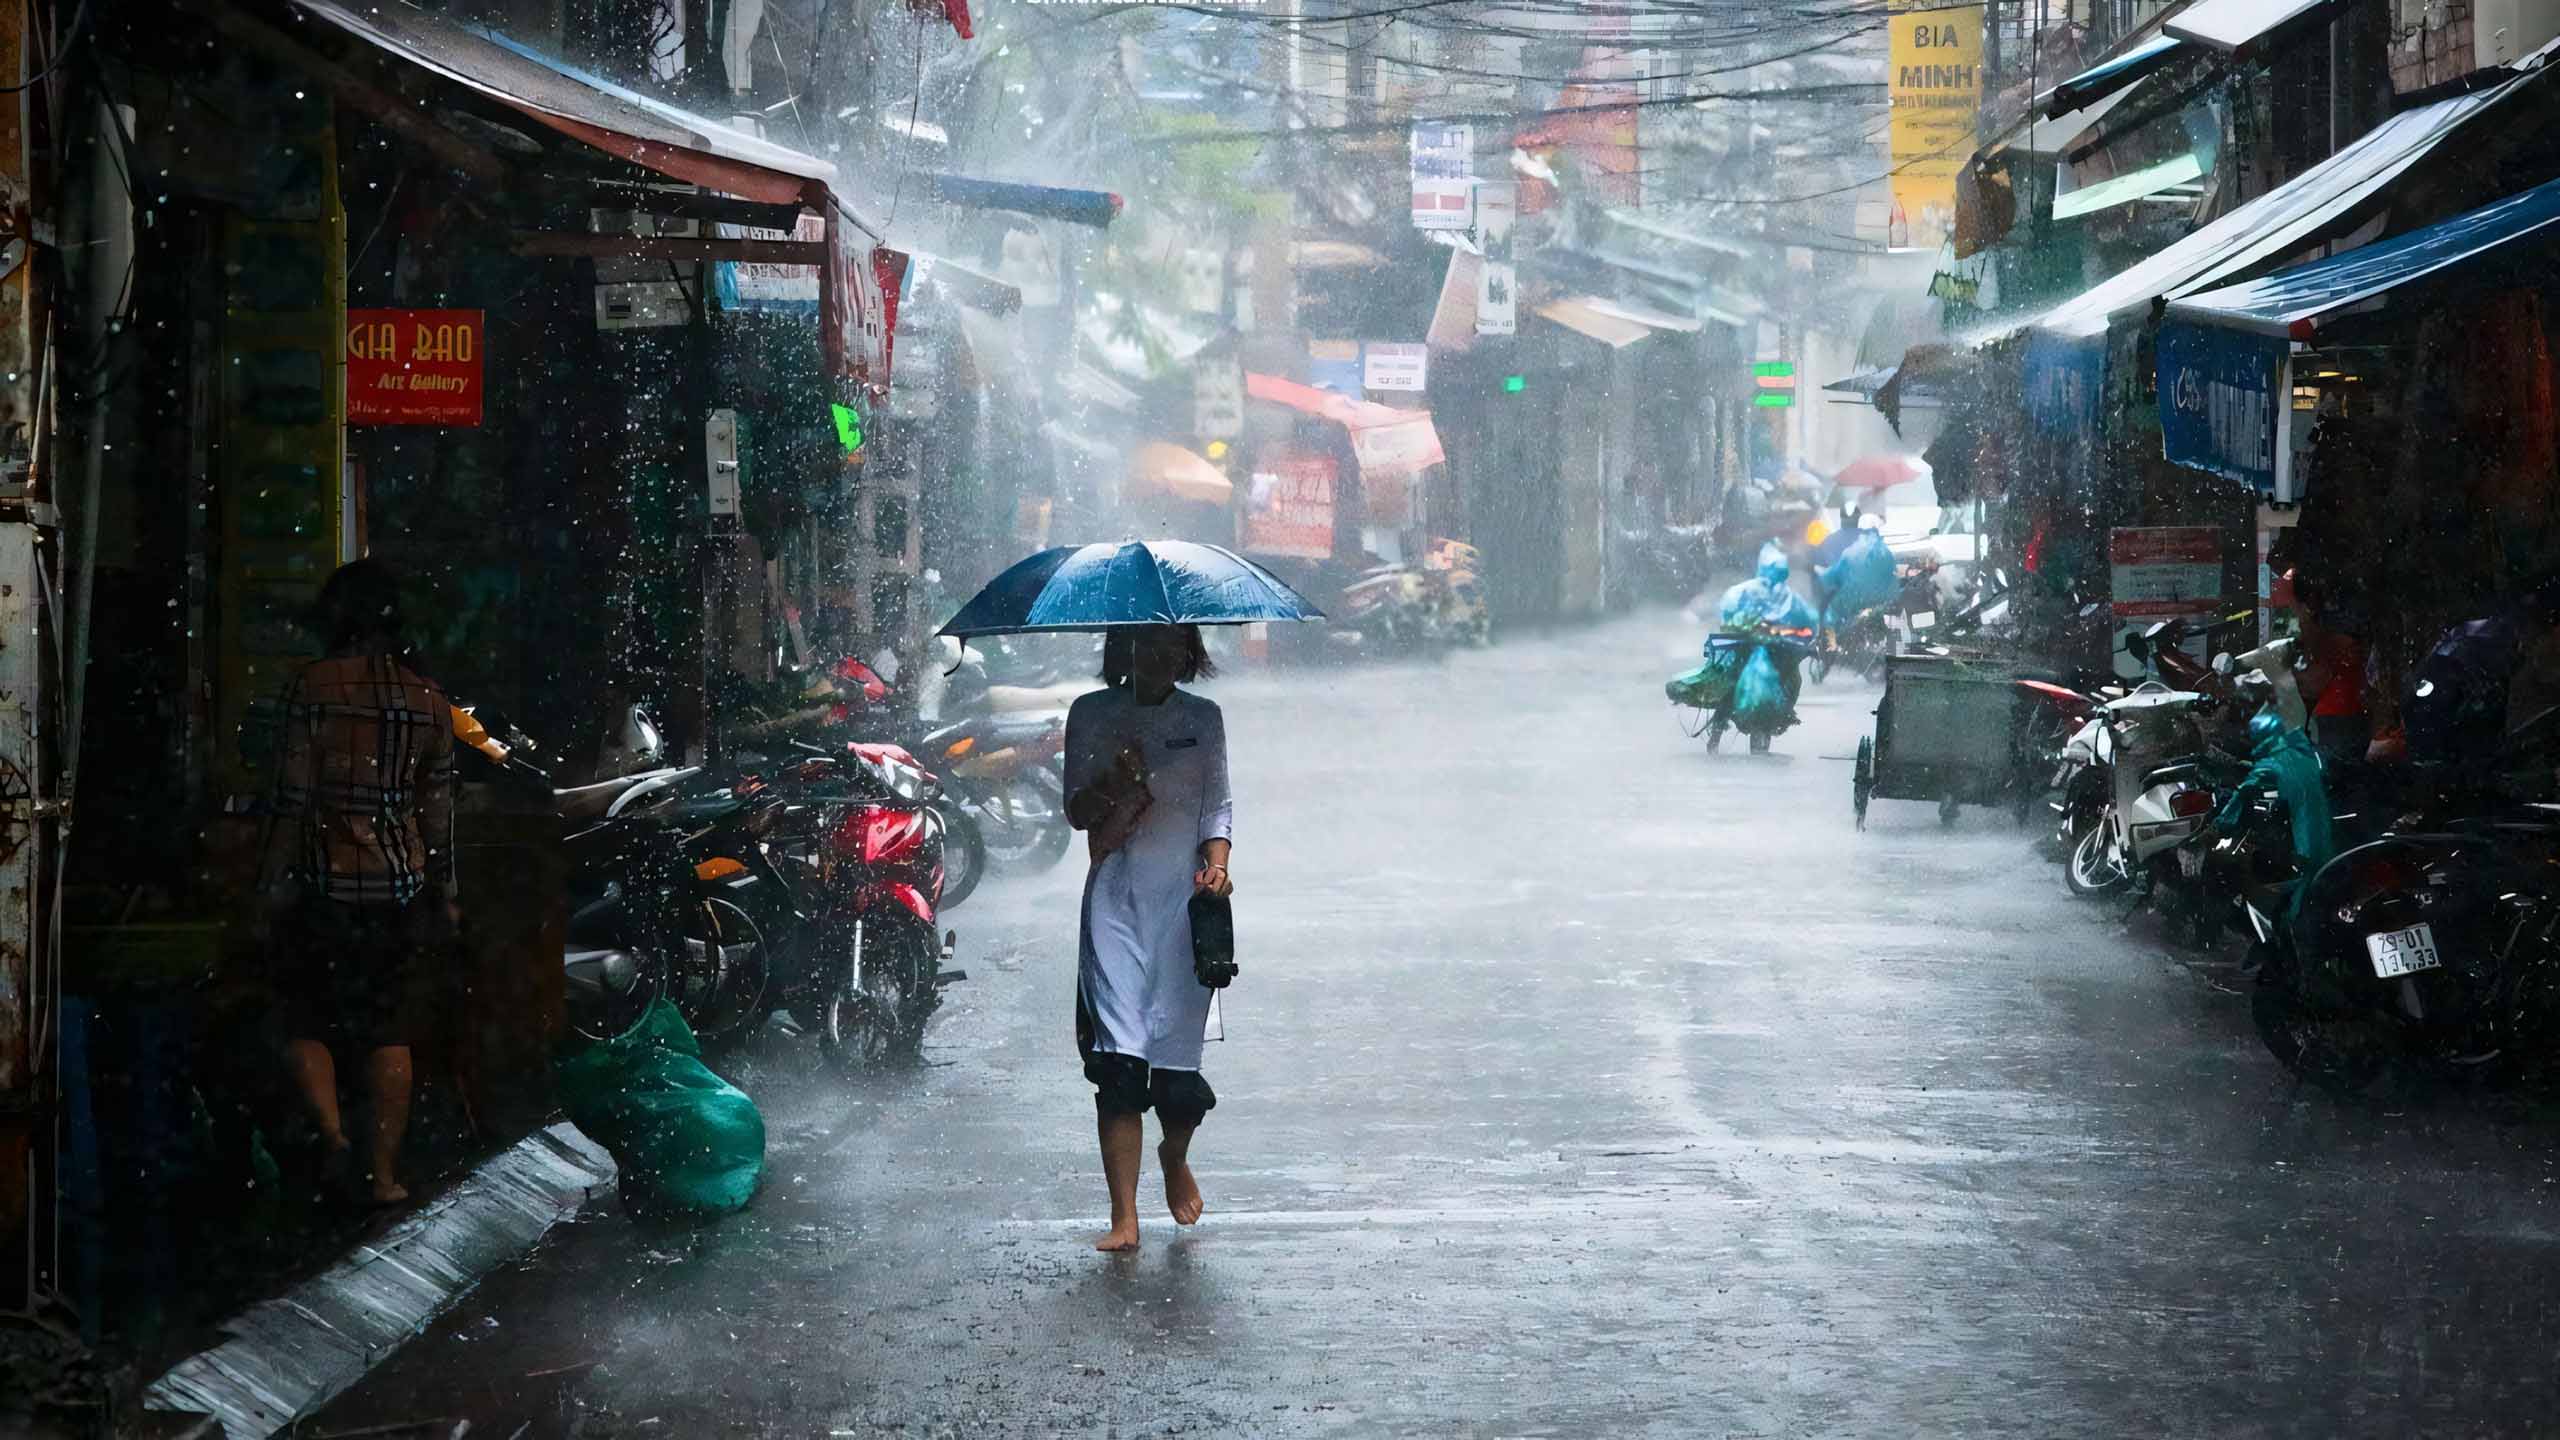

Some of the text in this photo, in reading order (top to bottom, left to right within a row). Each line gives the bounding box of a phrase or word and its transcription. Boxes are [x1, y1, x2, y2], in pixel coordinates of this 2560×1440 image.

[1914, 24, 1959, 48] BIA
[1899, 64, 1974, 88] MINH
[347, 323, 396, 362] GIA
